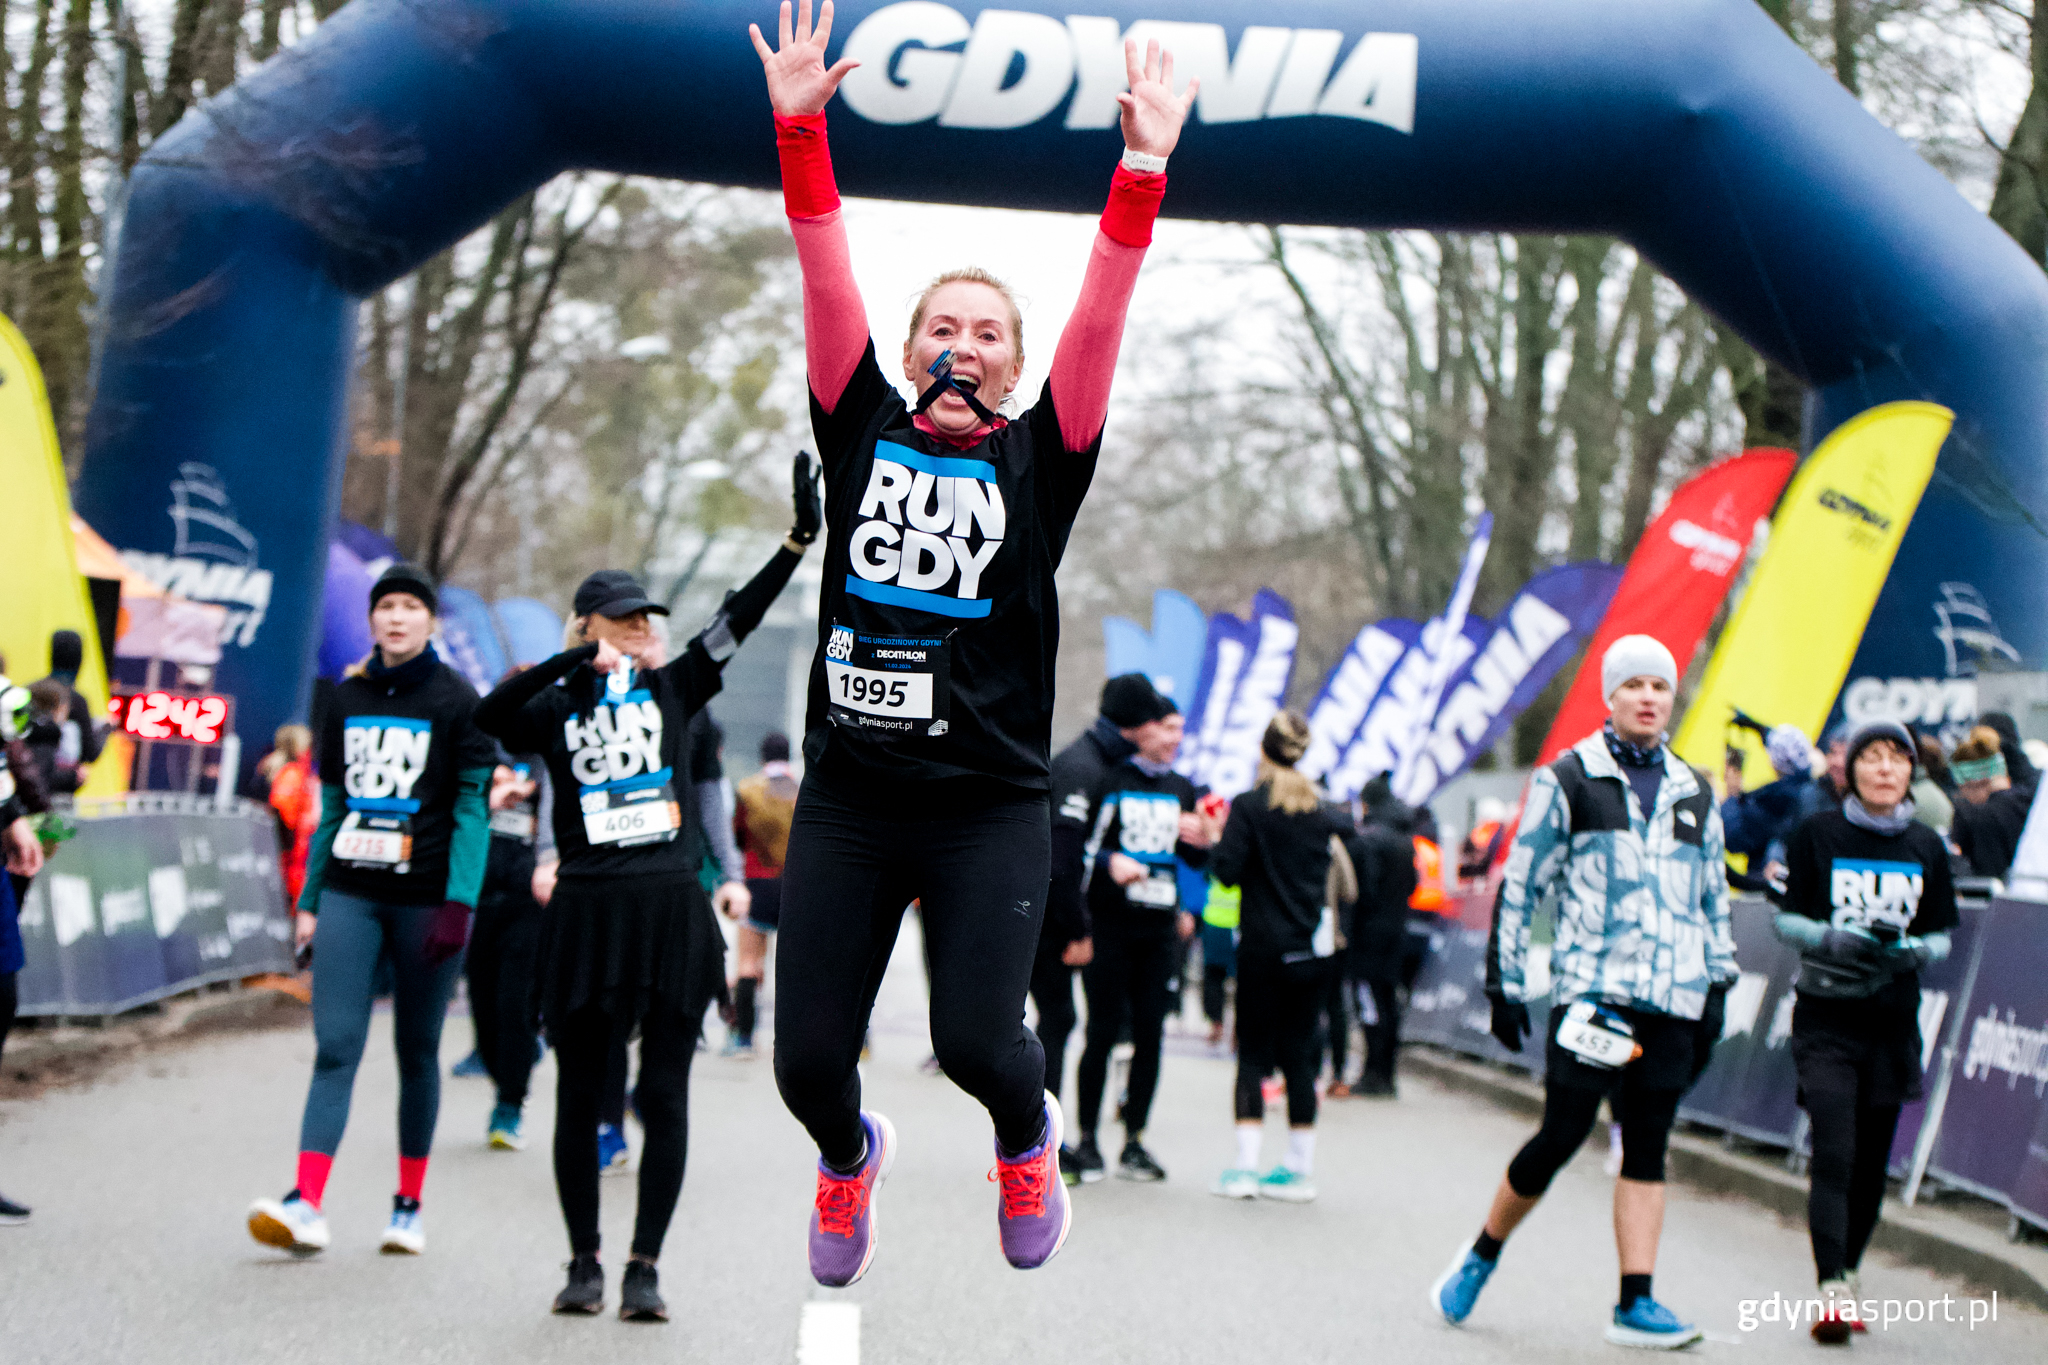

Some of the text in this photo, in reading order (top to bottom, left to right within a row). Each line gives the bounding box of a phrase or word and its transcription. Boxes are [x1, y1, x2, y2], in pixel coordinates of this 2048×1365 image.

[840, 0, 1419, 135] GDYNIA
[858, 457, 1006, 540] RUN
[849, 519, 1004, 600] GDY
[826, 642, 853, 662] GDY
[829, 628, 854, 649] RUN
[872, 637, 919, 646] URODZINOWY
[876, 649, 927, 660] DECATHLON
[840, 673, 908, 708] 1995
[564, 700, 663, 752] RUN
[858, 716, 913, 731] gdyniasport.pl
[343, 726, 431, 767] RUN
[571, 731, 663, 786] GDY
[344, 763, 426, 799] GDY
[604, 811, 646, 832] 406
[1831, 868, 1924, 916] RUN
[1574, 1031, 1613, 1055] 453
